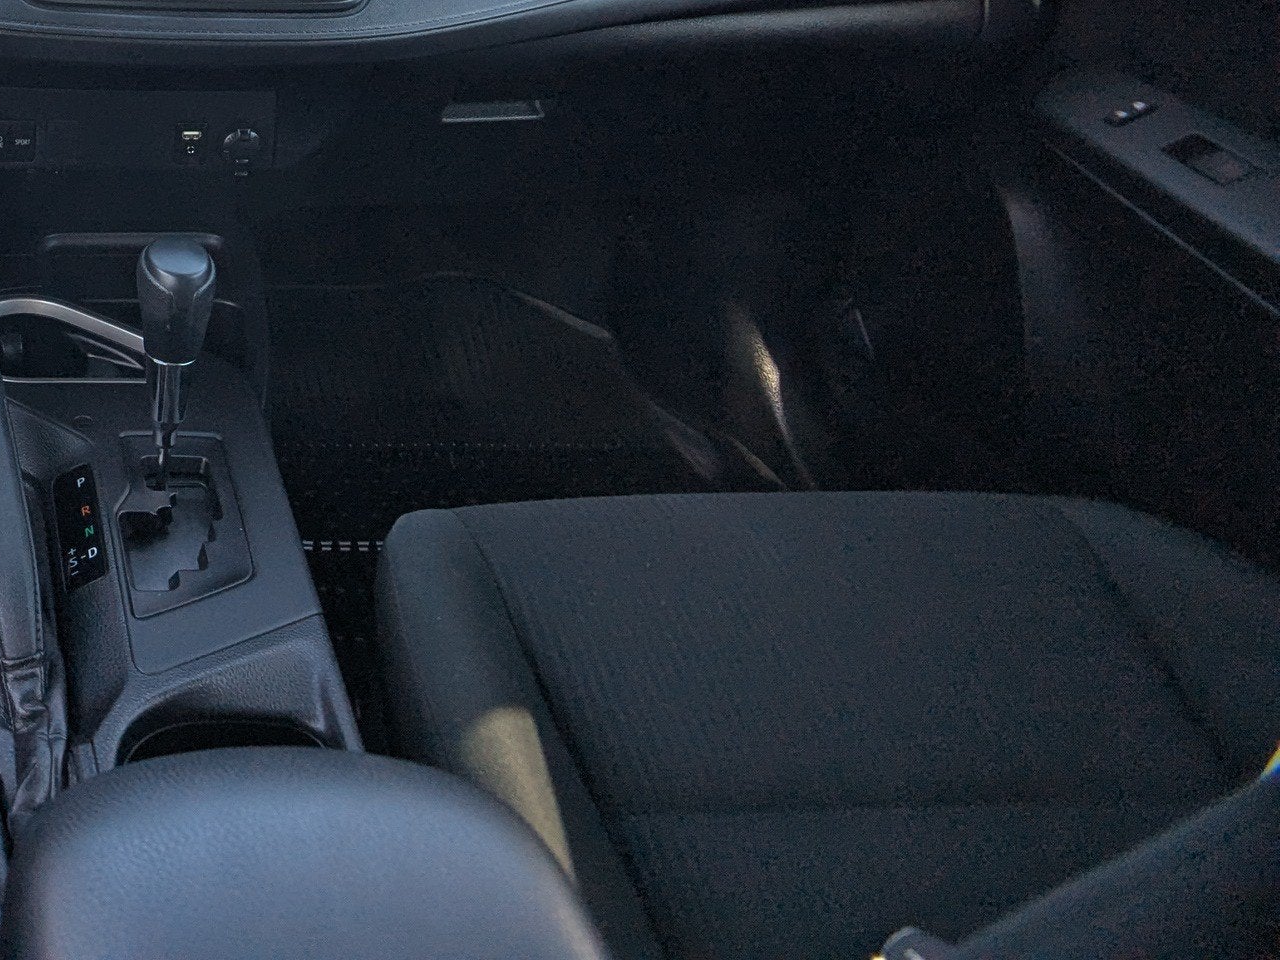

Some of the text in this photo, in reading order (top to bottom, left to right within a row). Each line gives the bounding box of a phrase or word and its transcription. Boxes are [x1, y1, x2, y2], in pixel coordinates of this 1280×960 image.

[77, 477, 85, 488] P
[81, 505, 91, 516] R
[84, 525, 94, 538] N
[69, 546, 98, 568] S D
